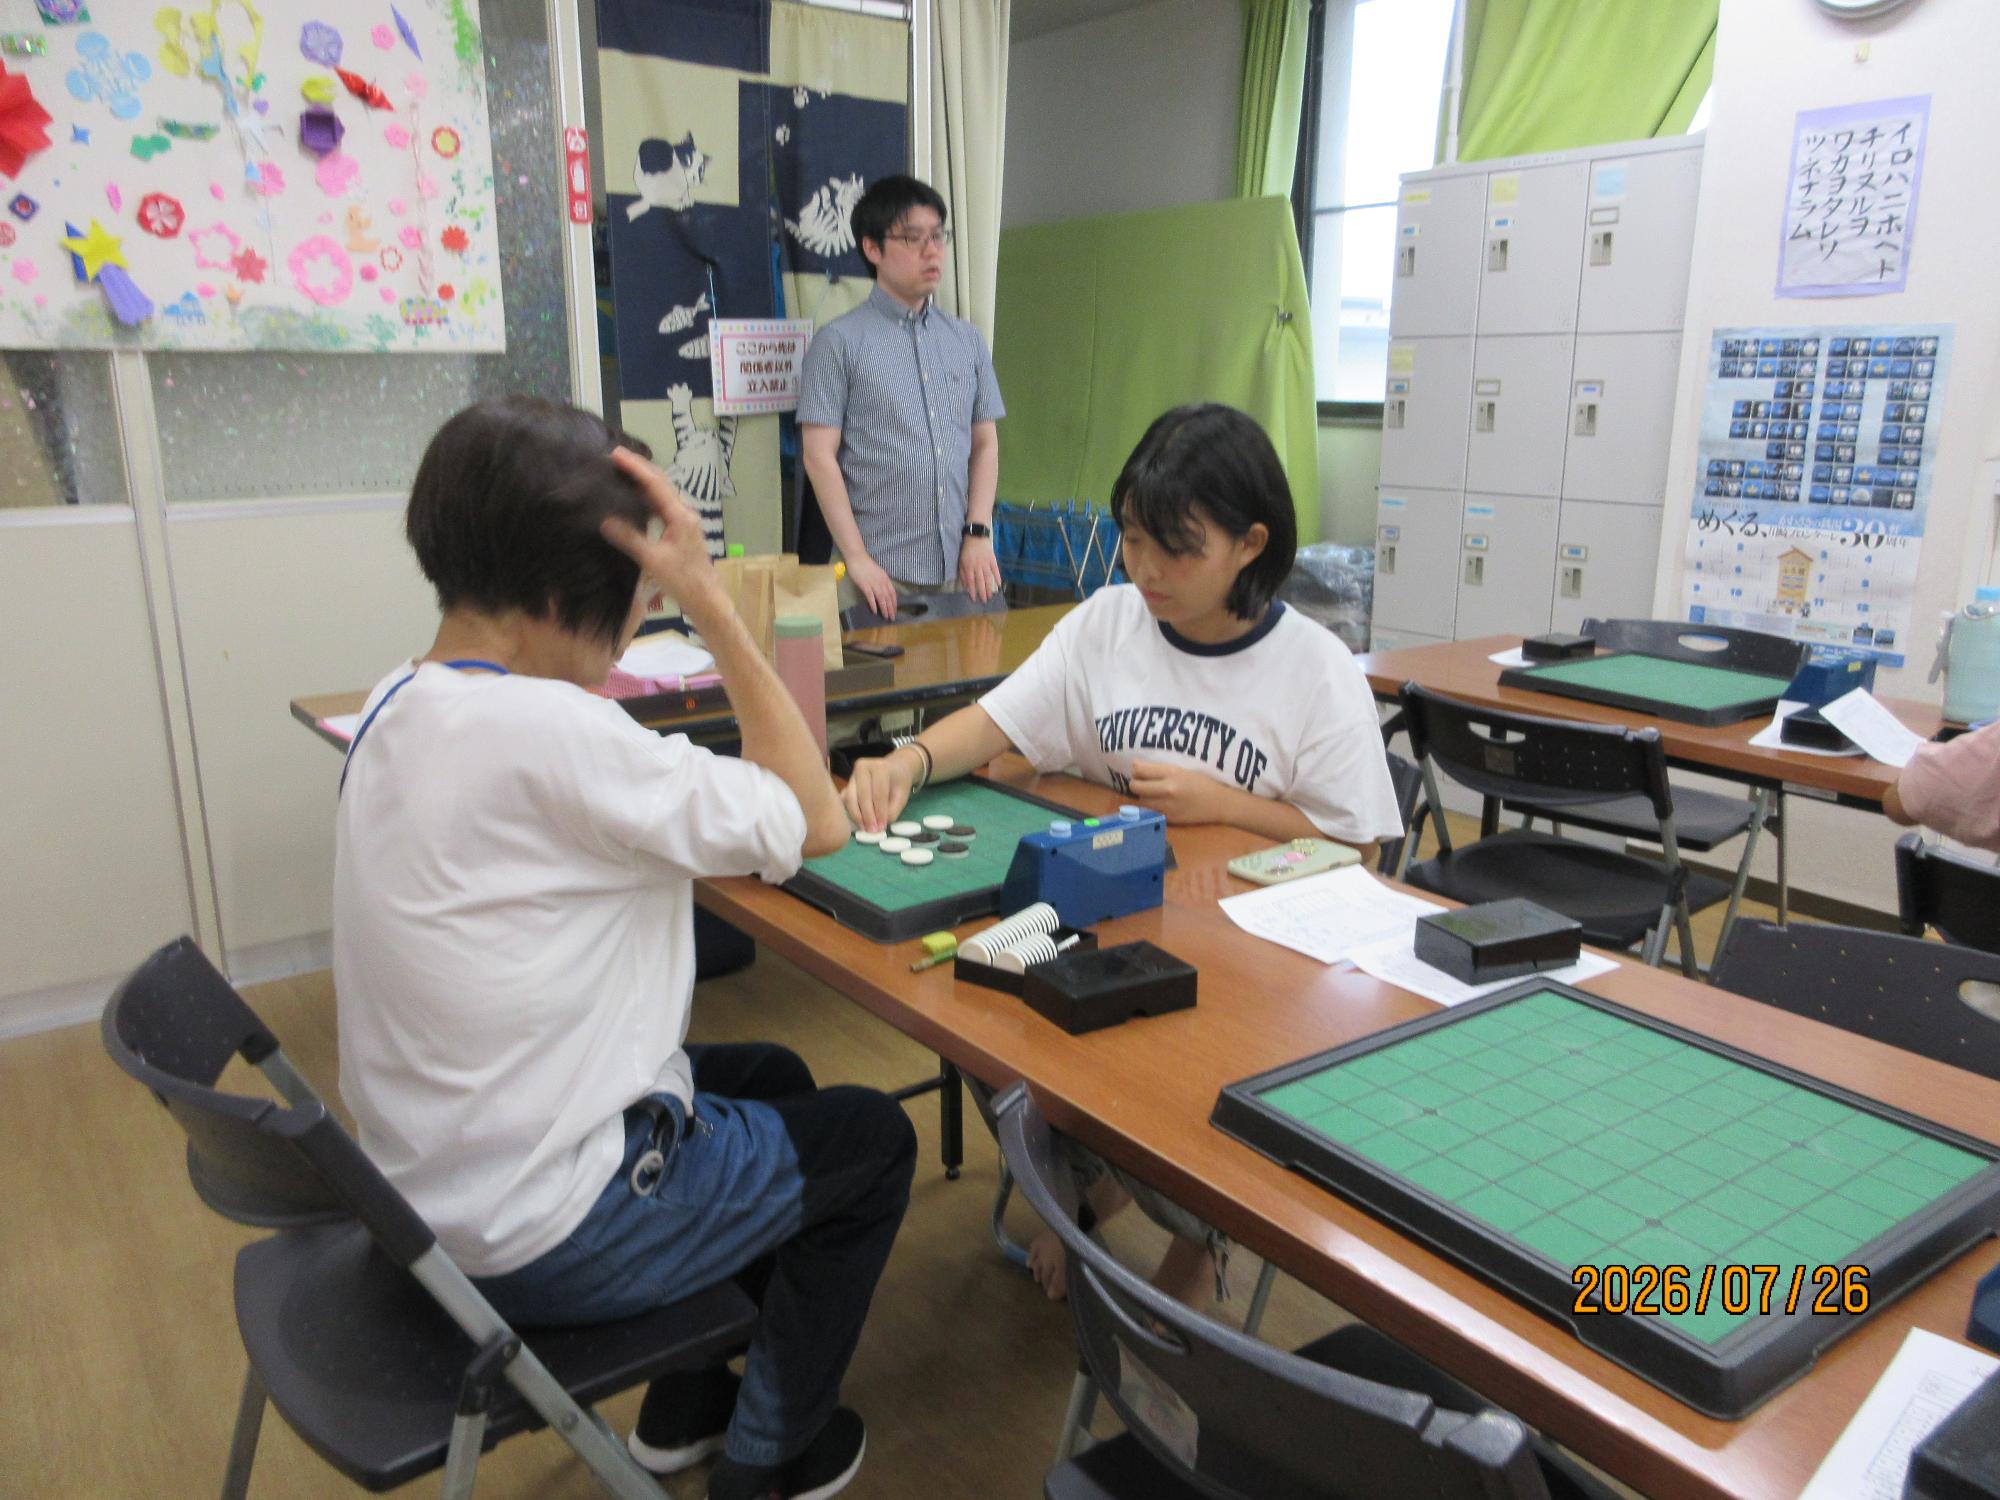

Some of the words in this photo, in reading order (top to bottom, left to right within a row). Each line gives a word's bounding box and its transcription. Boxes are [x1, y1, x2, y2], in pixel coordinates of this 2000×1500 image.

[1789, 135, 1825, 240] ツネナラム
[1874, 122, 1913, 279] イロハニホヘト
[736, 342, 796, 354] ここから先は
[740, 360, 792, 374] 関係者以外
[1235, 738, 1267, 793] OF
